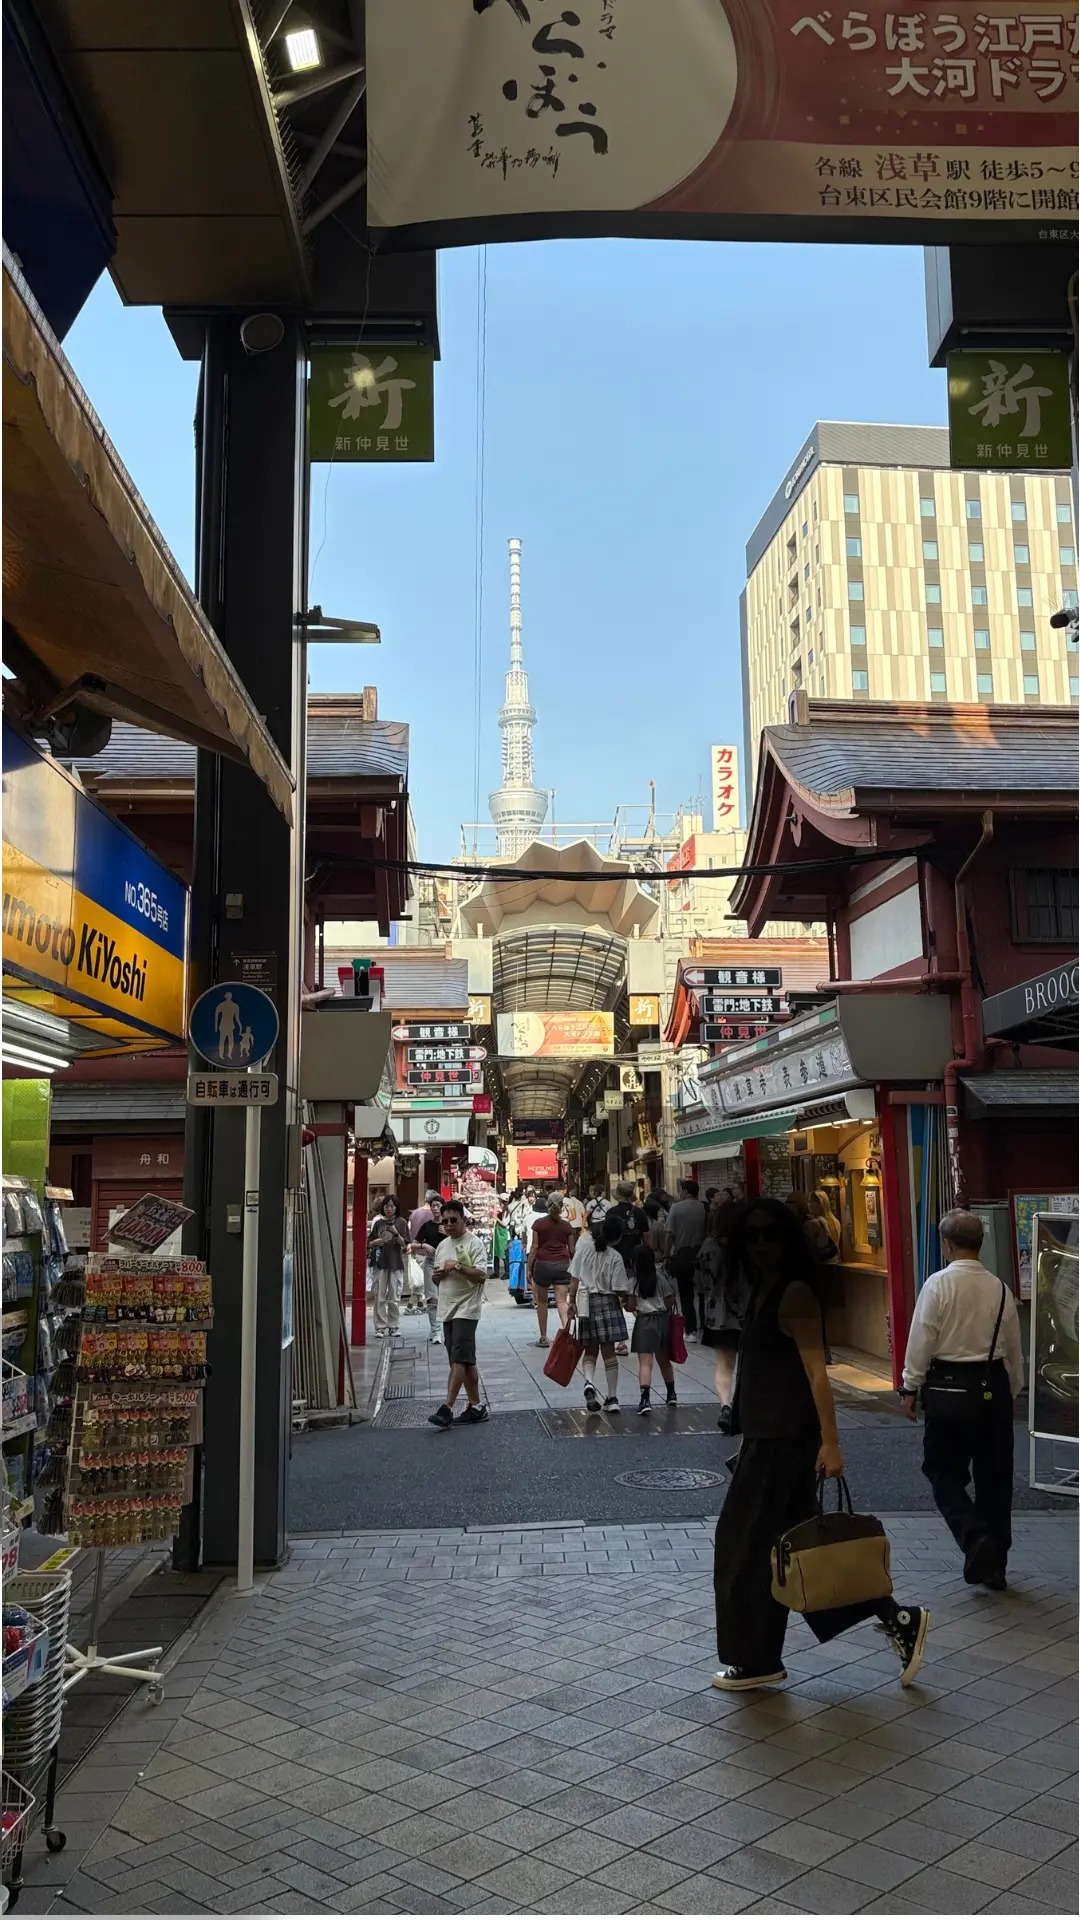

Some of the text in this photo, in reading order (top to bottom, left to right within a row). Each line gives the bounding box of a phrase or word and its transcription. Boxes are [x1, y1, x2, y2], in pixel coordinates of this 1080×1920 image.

[790, 10, 1078, 52] べらぼう江戸
[885, 57, 1078, 97] 大河ドラ
[814, 156, 863, 178] 各線
[328, 352, 416, 429] 新
[968, 360, 1053, 437] 新
[335, 436, 410, 451] 新仲見世
[977, 444, 1048, 459] 新仲見世
[716, 749, 735, 817] カラオケ
[79, 923, 147, 1002] KiYoshi
[718, 970, 766, 984] 観音様
[634, 997, 654, 1018] 新
[419, 1026, 459, 1038] 観音様
[420, 1070, 459, 1082] 仲見世
[195, 1079, 271, 1099] 自転車は通行可
[139, 1153, 169, 1165] 舟和
[114, 1214, 172, 1247] JAPAN
